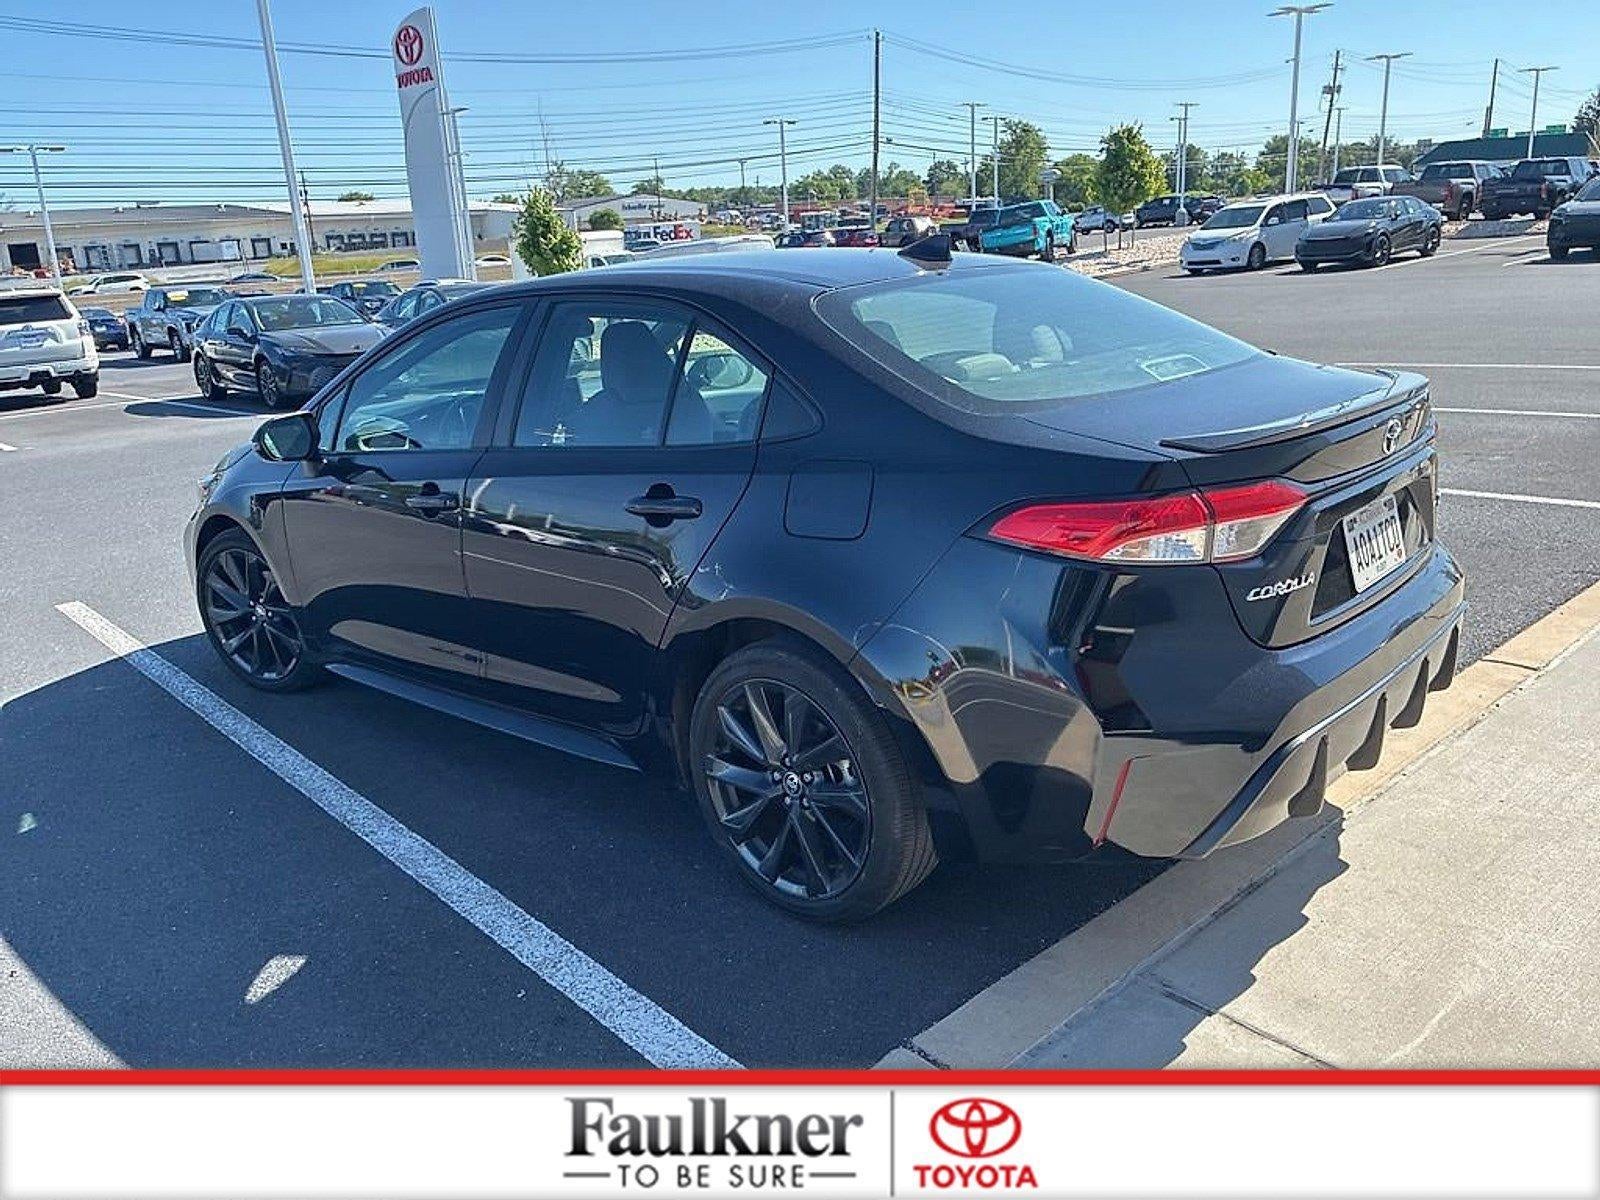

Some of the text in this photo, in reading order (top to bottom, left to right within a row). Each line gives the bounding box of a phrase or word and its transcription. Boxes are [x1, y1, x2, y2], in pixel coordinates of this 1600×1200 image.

[396, 67, 434, 88] TOYOTA
[653, 224, 694, 242] FedEx
[1247, 573, 1315, 601] COROLLA
